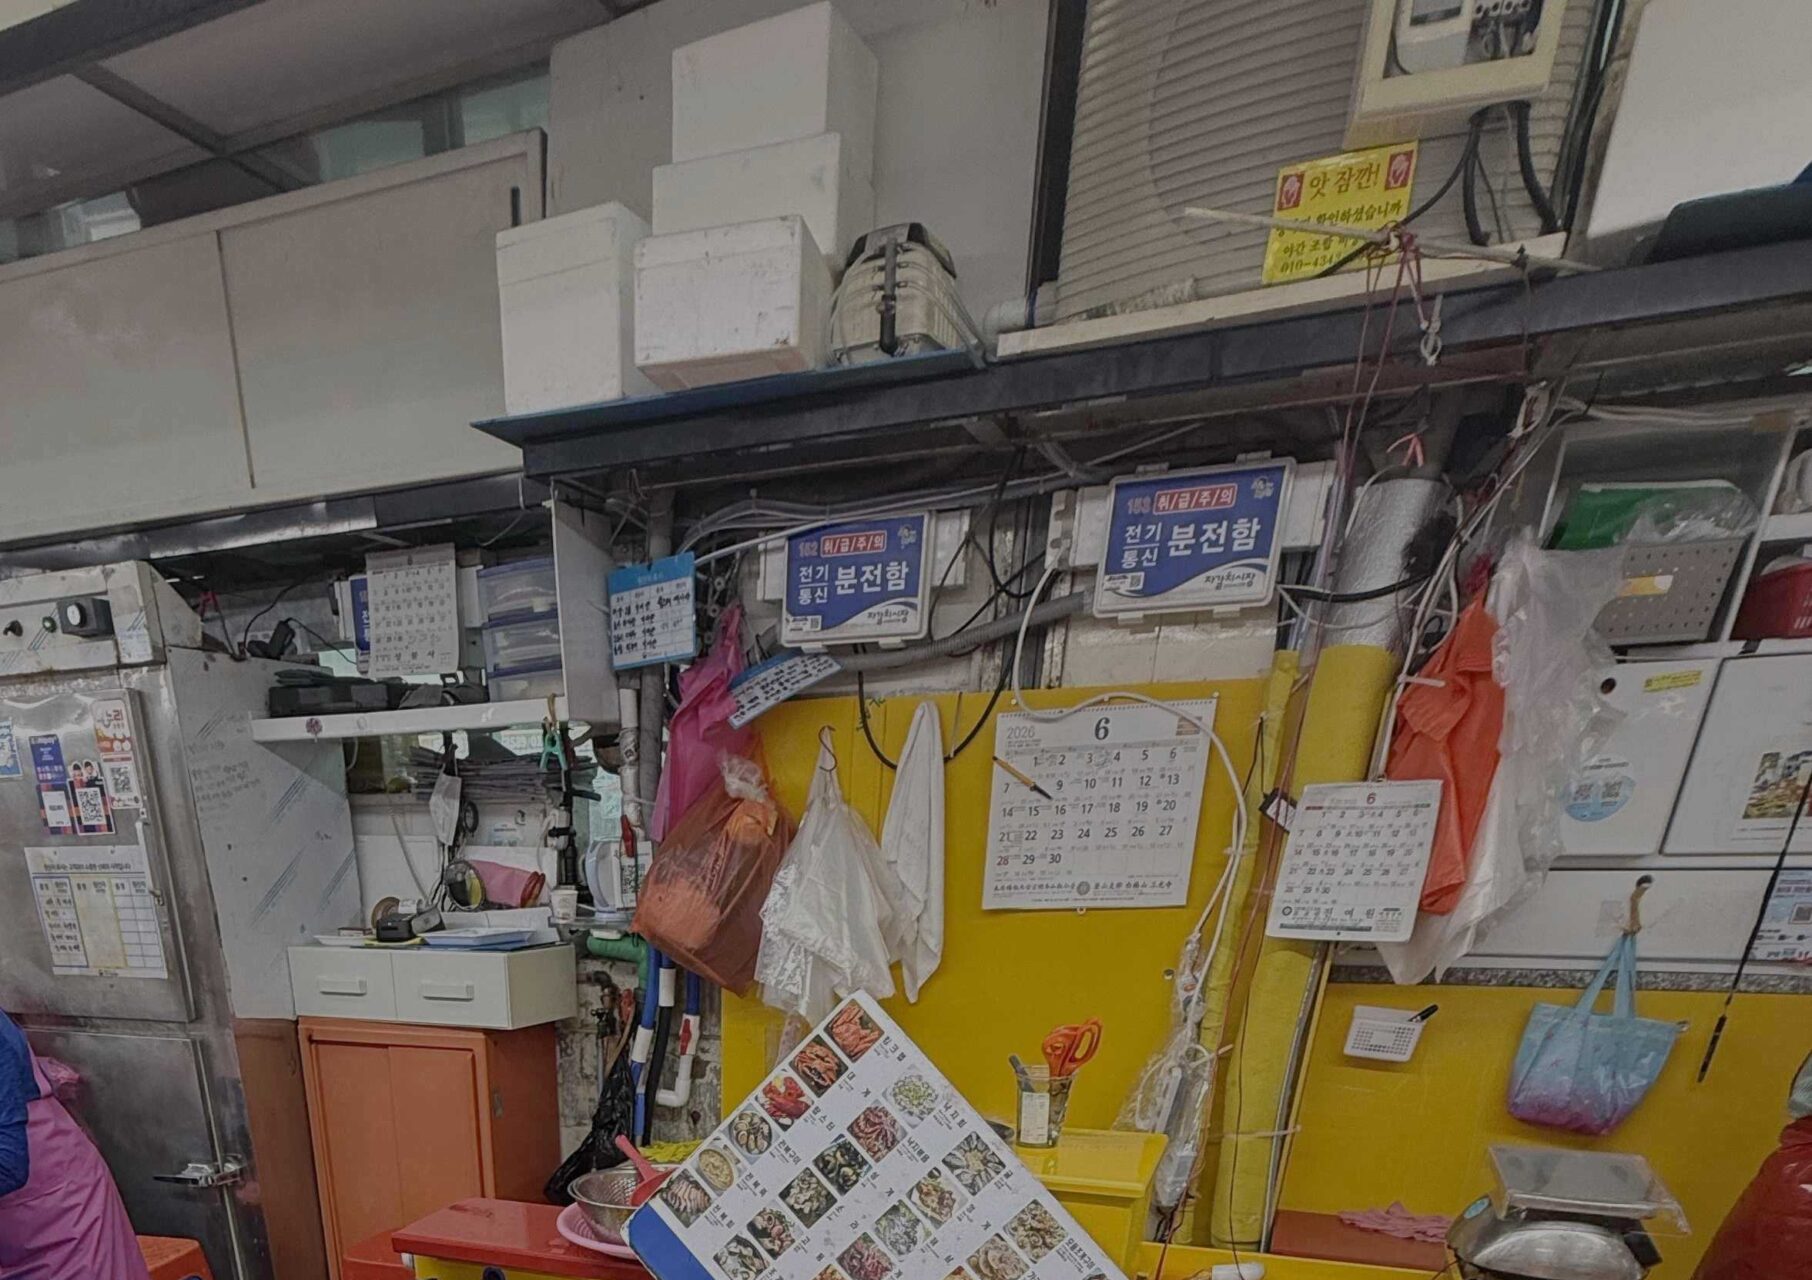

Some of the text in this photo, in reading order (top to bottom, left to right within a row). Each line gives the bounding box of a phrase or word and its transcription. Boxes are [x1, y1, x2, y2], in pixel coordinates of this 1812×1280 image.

[1310, 162, 1381, 200] 앗 잠깐!
[1158, 487, 1233, 510] 취/급/주/의
[1125, 522, 1162, 544] 전기
[1167, 517, 1261, 556] 분전함
[824, 533, 884, 553] 취/급/주/의
[1121, 548, 1158, 569] 통신
[799, 564, 829, 582] 전기
[835, 560, 909, 595] 분전함
[1204, 571, 1256, 590] 자갈치시장
[798, 586, 828, 605] 통신
[1095, 717, 1110, 740] 6
[1033, 748, 1177, 767] 1 2 3 4 5 6
[1003, 774, 1180, 793] 7 9 10 11 12 13
[1366, 793, 1376, 804] 6
[1002, 800, 1176, 818] 14 15 16 17 18 19 20
[999, 825, 1173, 842] 21 22 23 24 25 26 27
[997, 853, 1061, 866] 28 29 30
